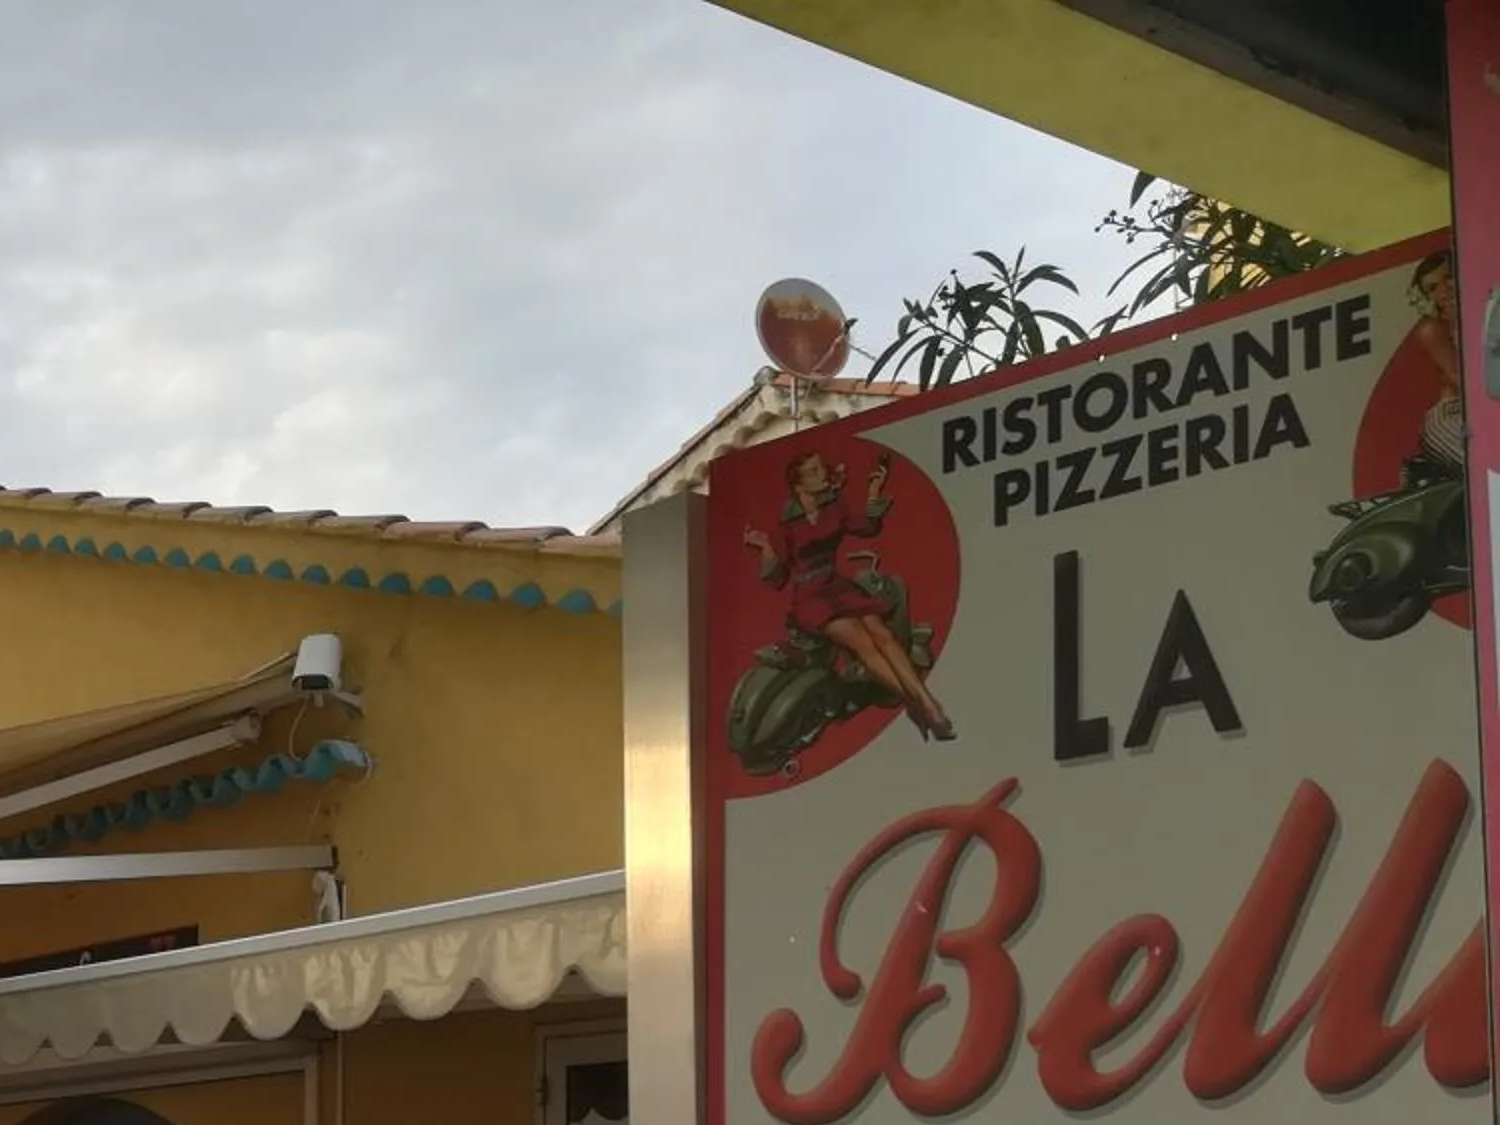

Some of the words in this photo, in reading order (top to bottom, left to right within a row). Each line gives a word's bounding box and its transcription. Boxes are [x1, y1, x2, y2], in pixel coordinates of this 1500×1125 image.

[942, 293, 1373, 475] RISTORANTE
[993, 392, 1311, 527] PIZZERIA
[1054, 549, 1242, 762] LA
